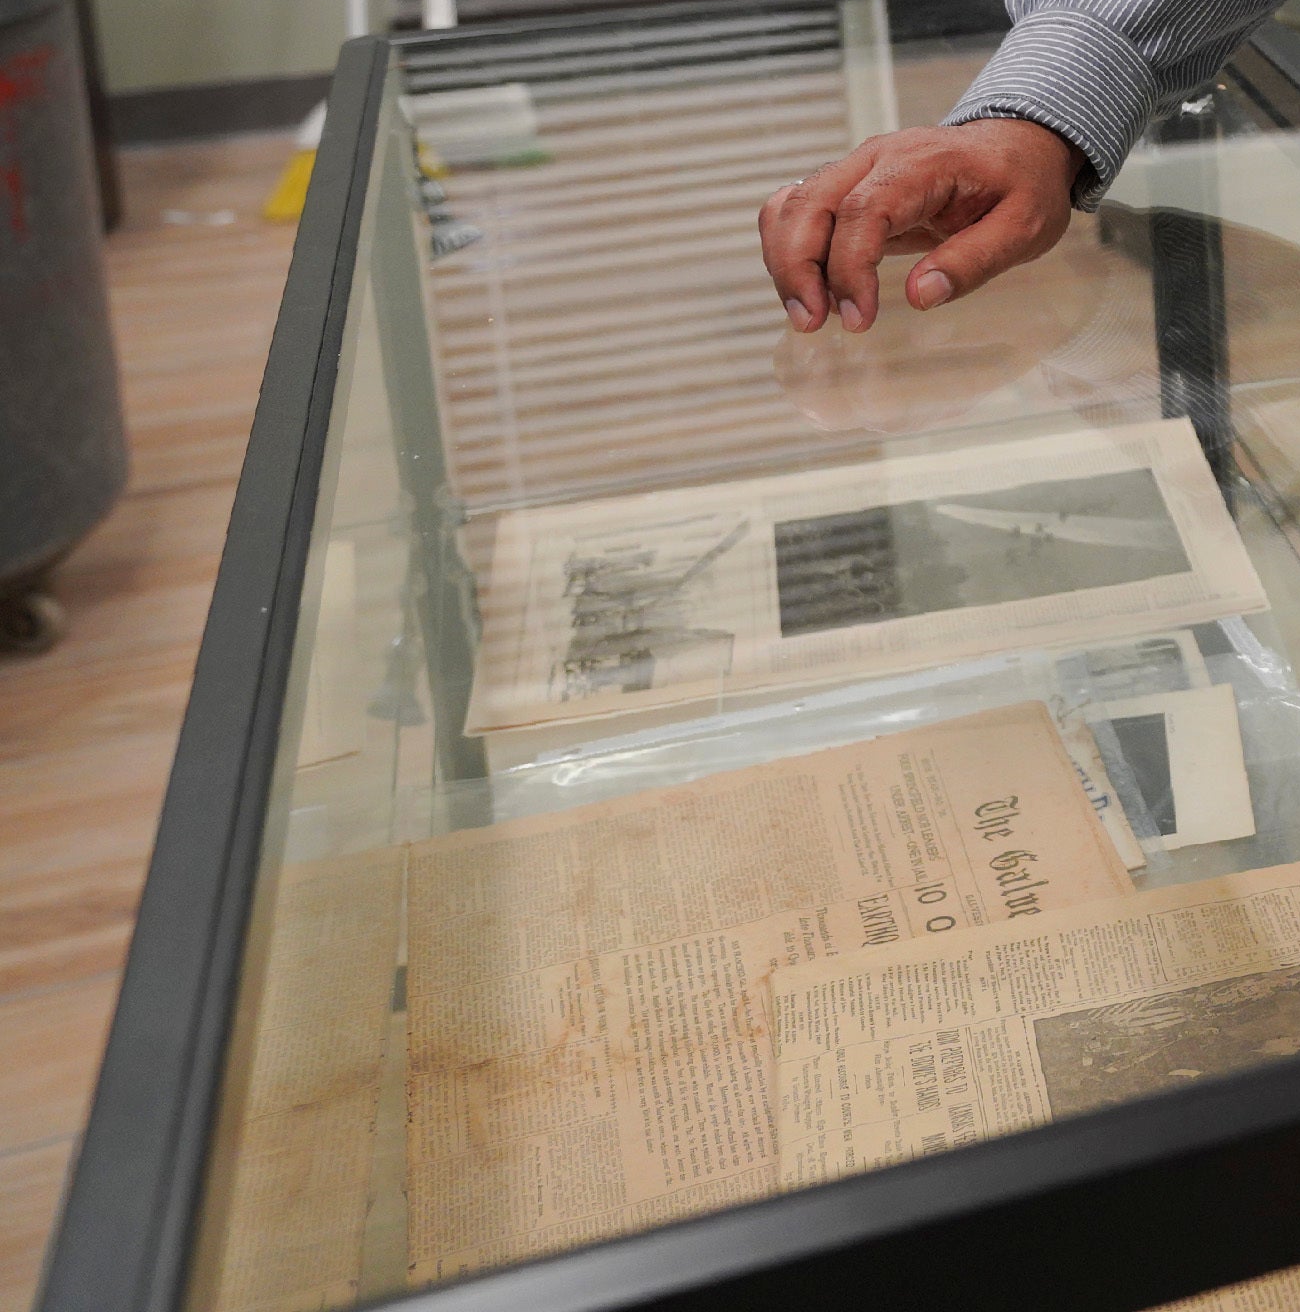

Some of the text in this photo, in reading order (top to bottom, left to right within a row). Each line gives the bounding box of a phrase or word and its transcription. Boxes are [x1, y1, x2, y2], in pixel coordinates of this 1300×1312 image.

[974, 795, 1050, 919] The Galve
[858, 895, 898, 946] EARTHQ
